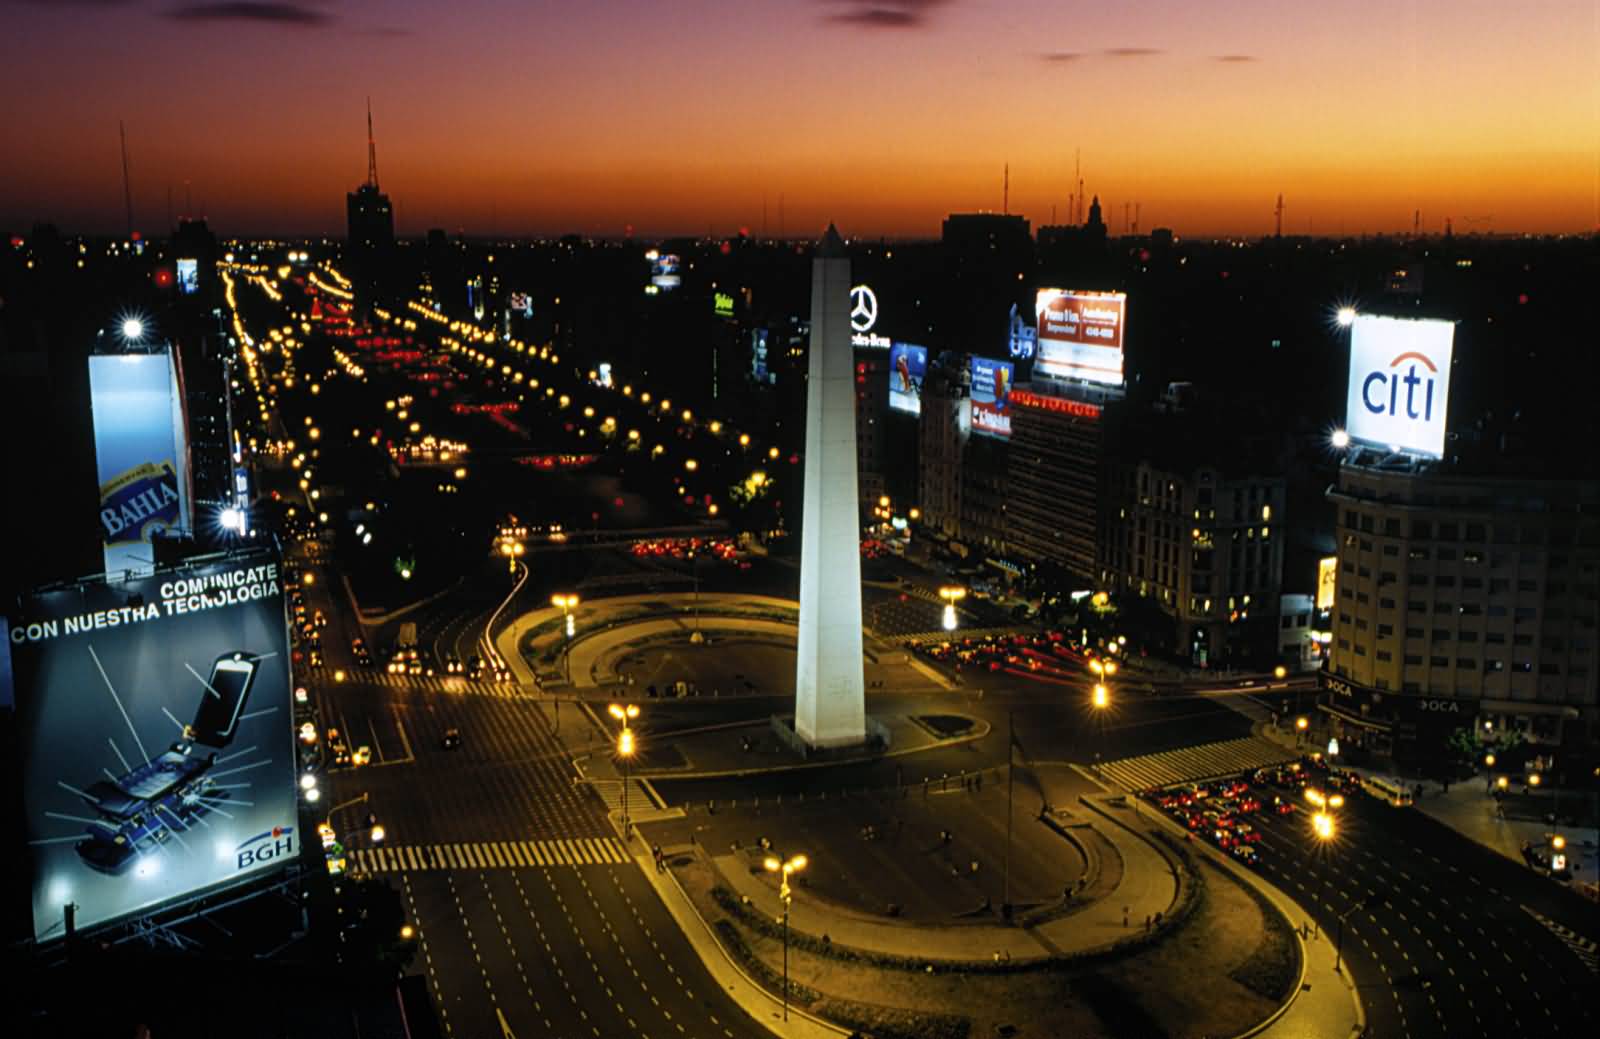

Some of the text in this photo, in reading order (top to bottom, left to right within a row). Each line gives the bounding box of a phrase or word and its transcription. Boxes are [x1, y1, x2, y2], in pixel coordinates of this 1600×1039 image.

[1361, 364, 1435, 422] citi
[100, 481, 178, 536] BAHIA
[11, 580, 280, 644] CON NUESTRA TECNOLOGIA
[238, 836, 292, 870] BGH
